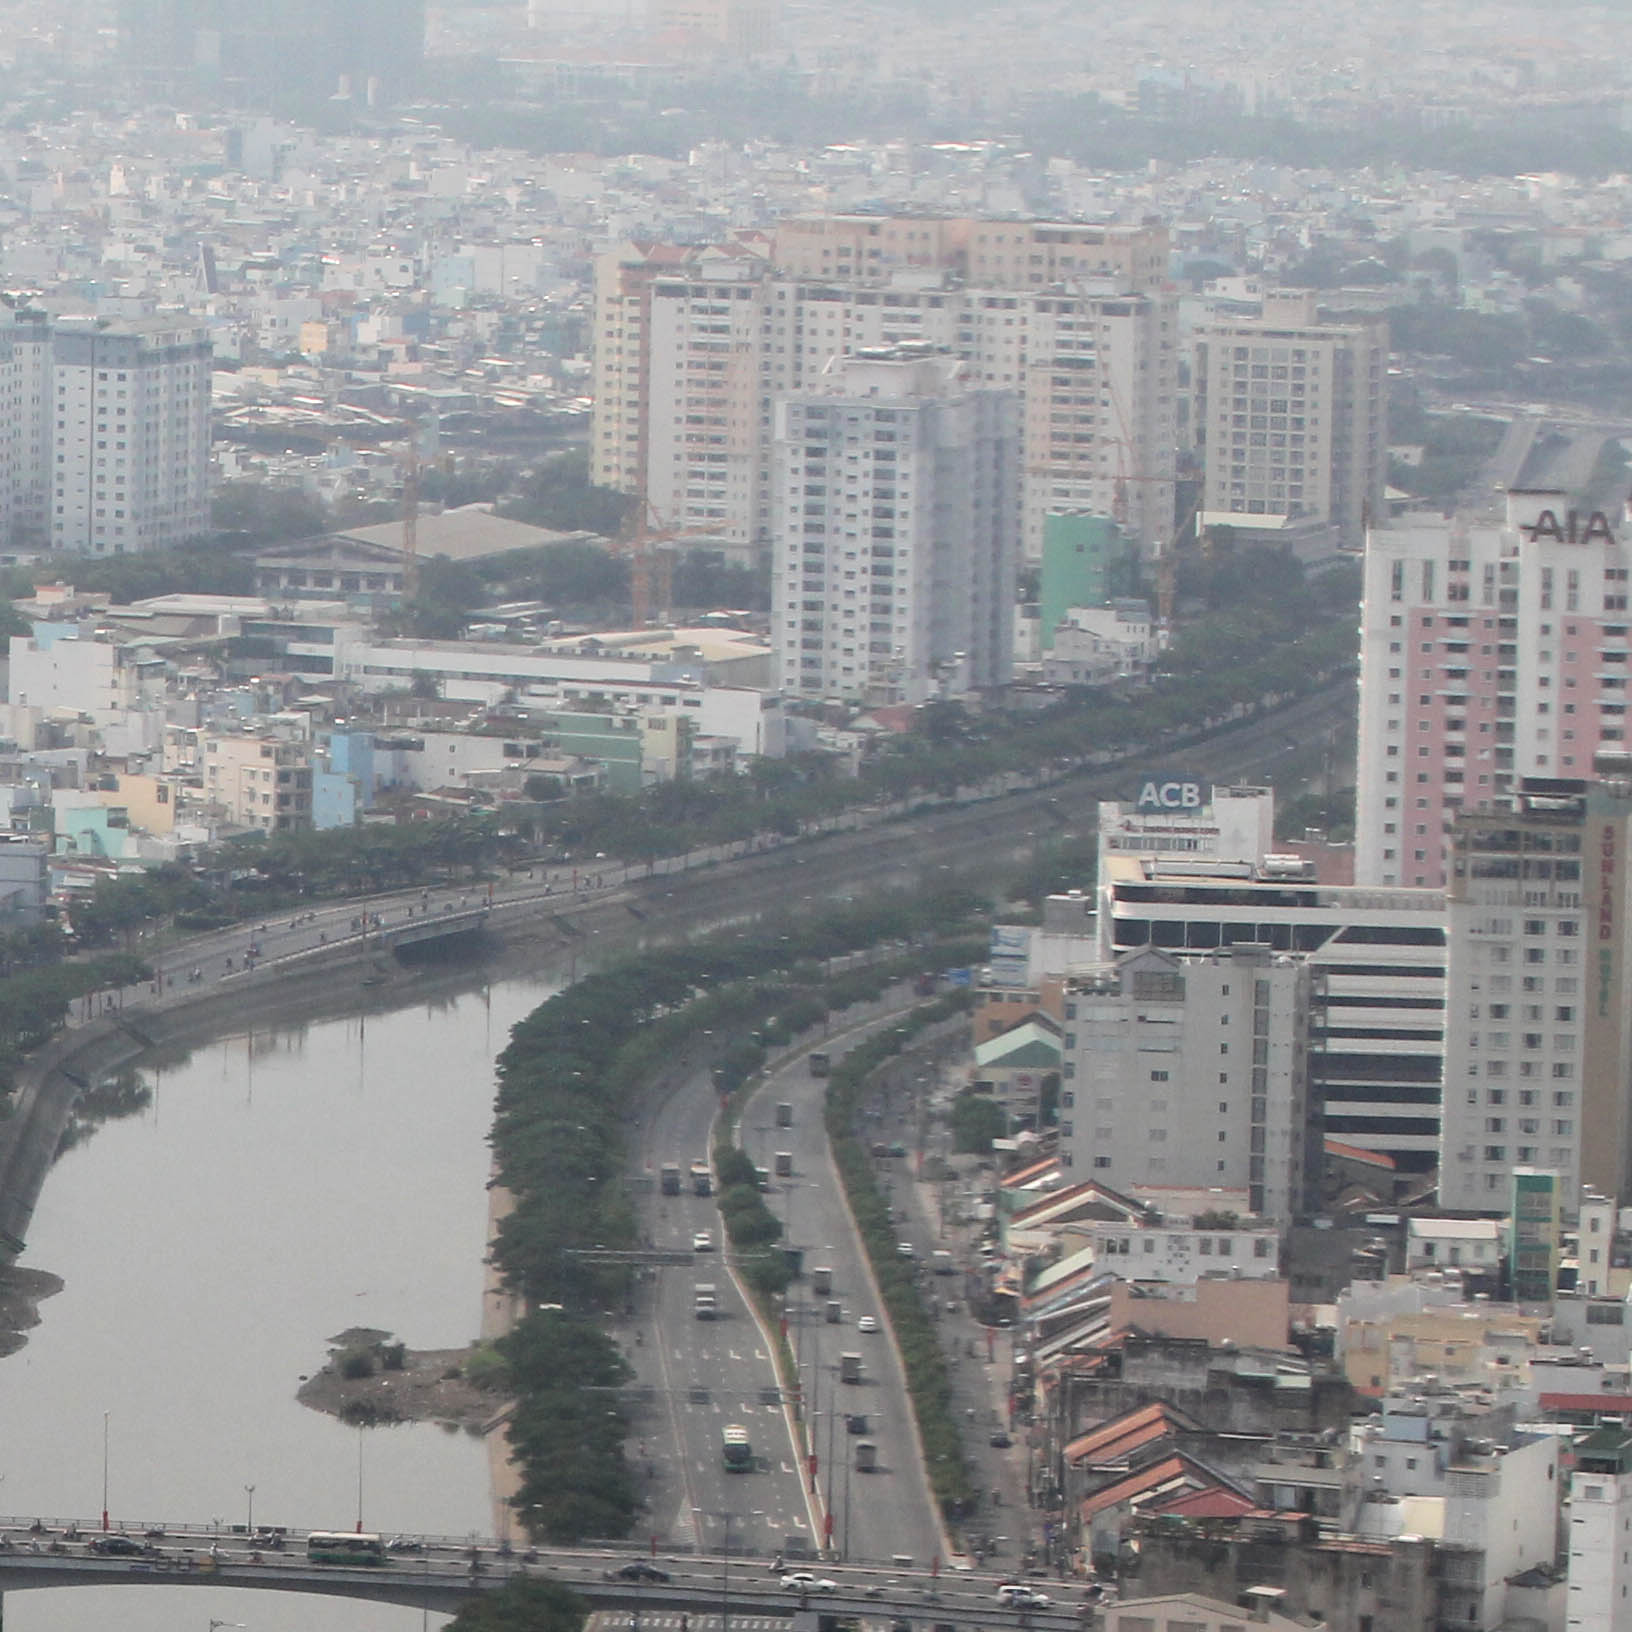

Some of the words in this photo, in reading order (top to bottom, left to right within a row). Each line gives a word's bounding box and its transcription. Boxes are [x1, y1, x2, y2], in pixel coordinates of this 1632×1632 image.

[1529, 509, 1616, 545] AIA
[1138, 782, 1201, 808] ACB
[1599, 825, 1615, 941] SUNLAND
